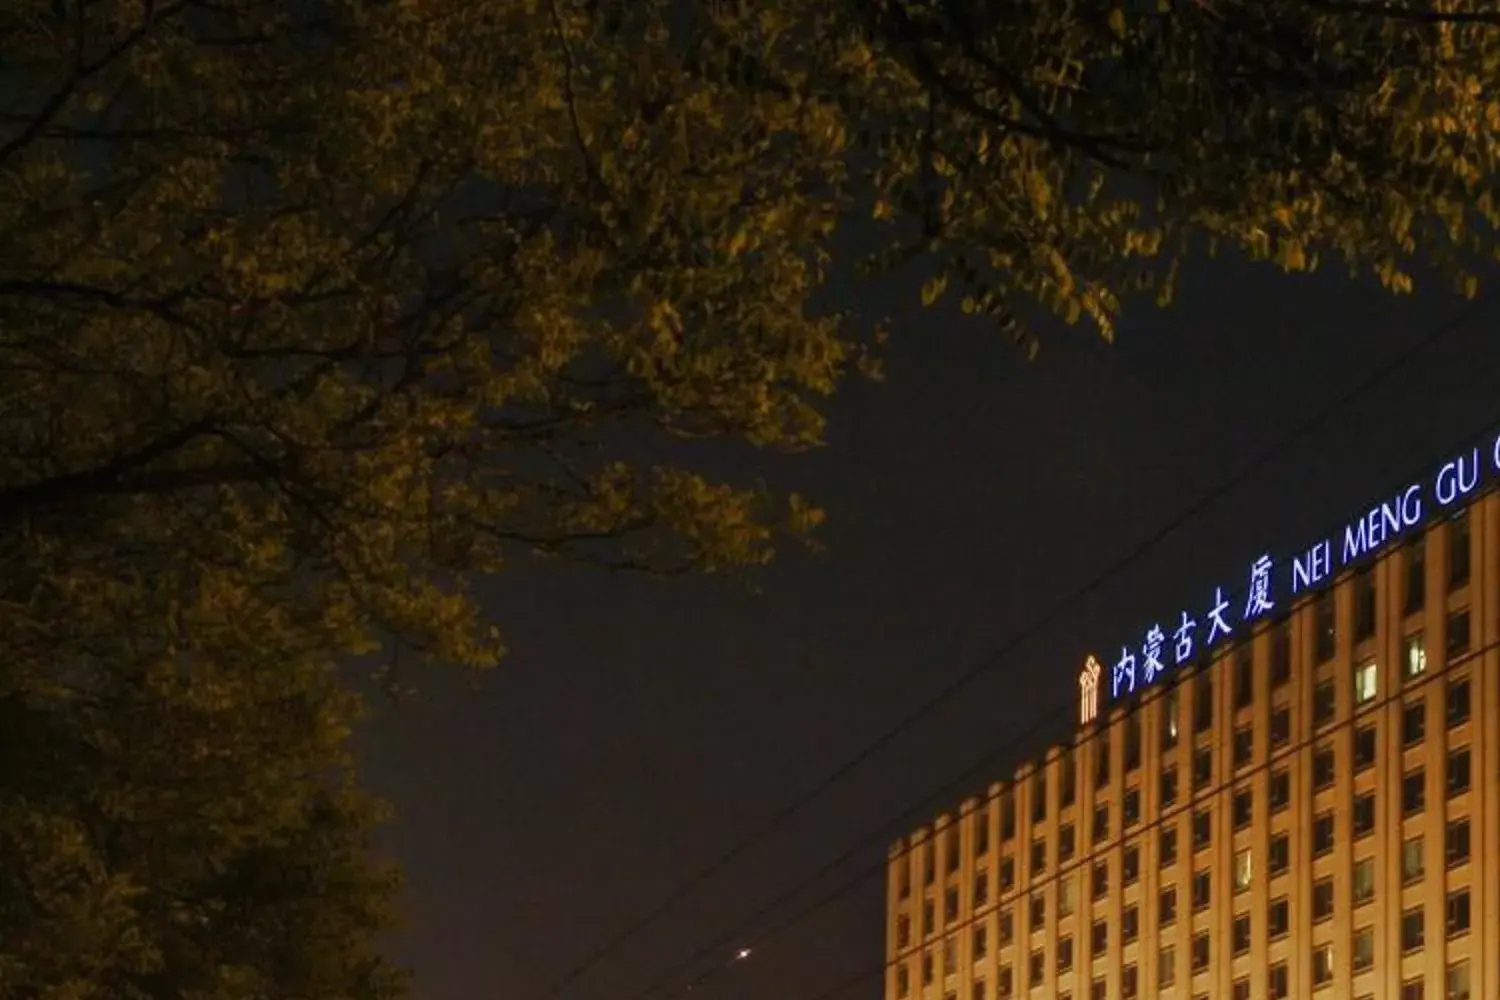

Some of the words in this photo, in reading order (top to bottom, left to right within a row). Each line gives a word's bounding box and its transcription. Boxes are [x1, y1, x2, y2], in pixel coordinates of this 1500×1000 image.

[1292, 538, 1331, 594] NEI
[1342, 484, 1422, 565] MENG
[1435, 447, 1479, 506] GU
[1112, 554, 1276, 698] 内蒙古大厦
